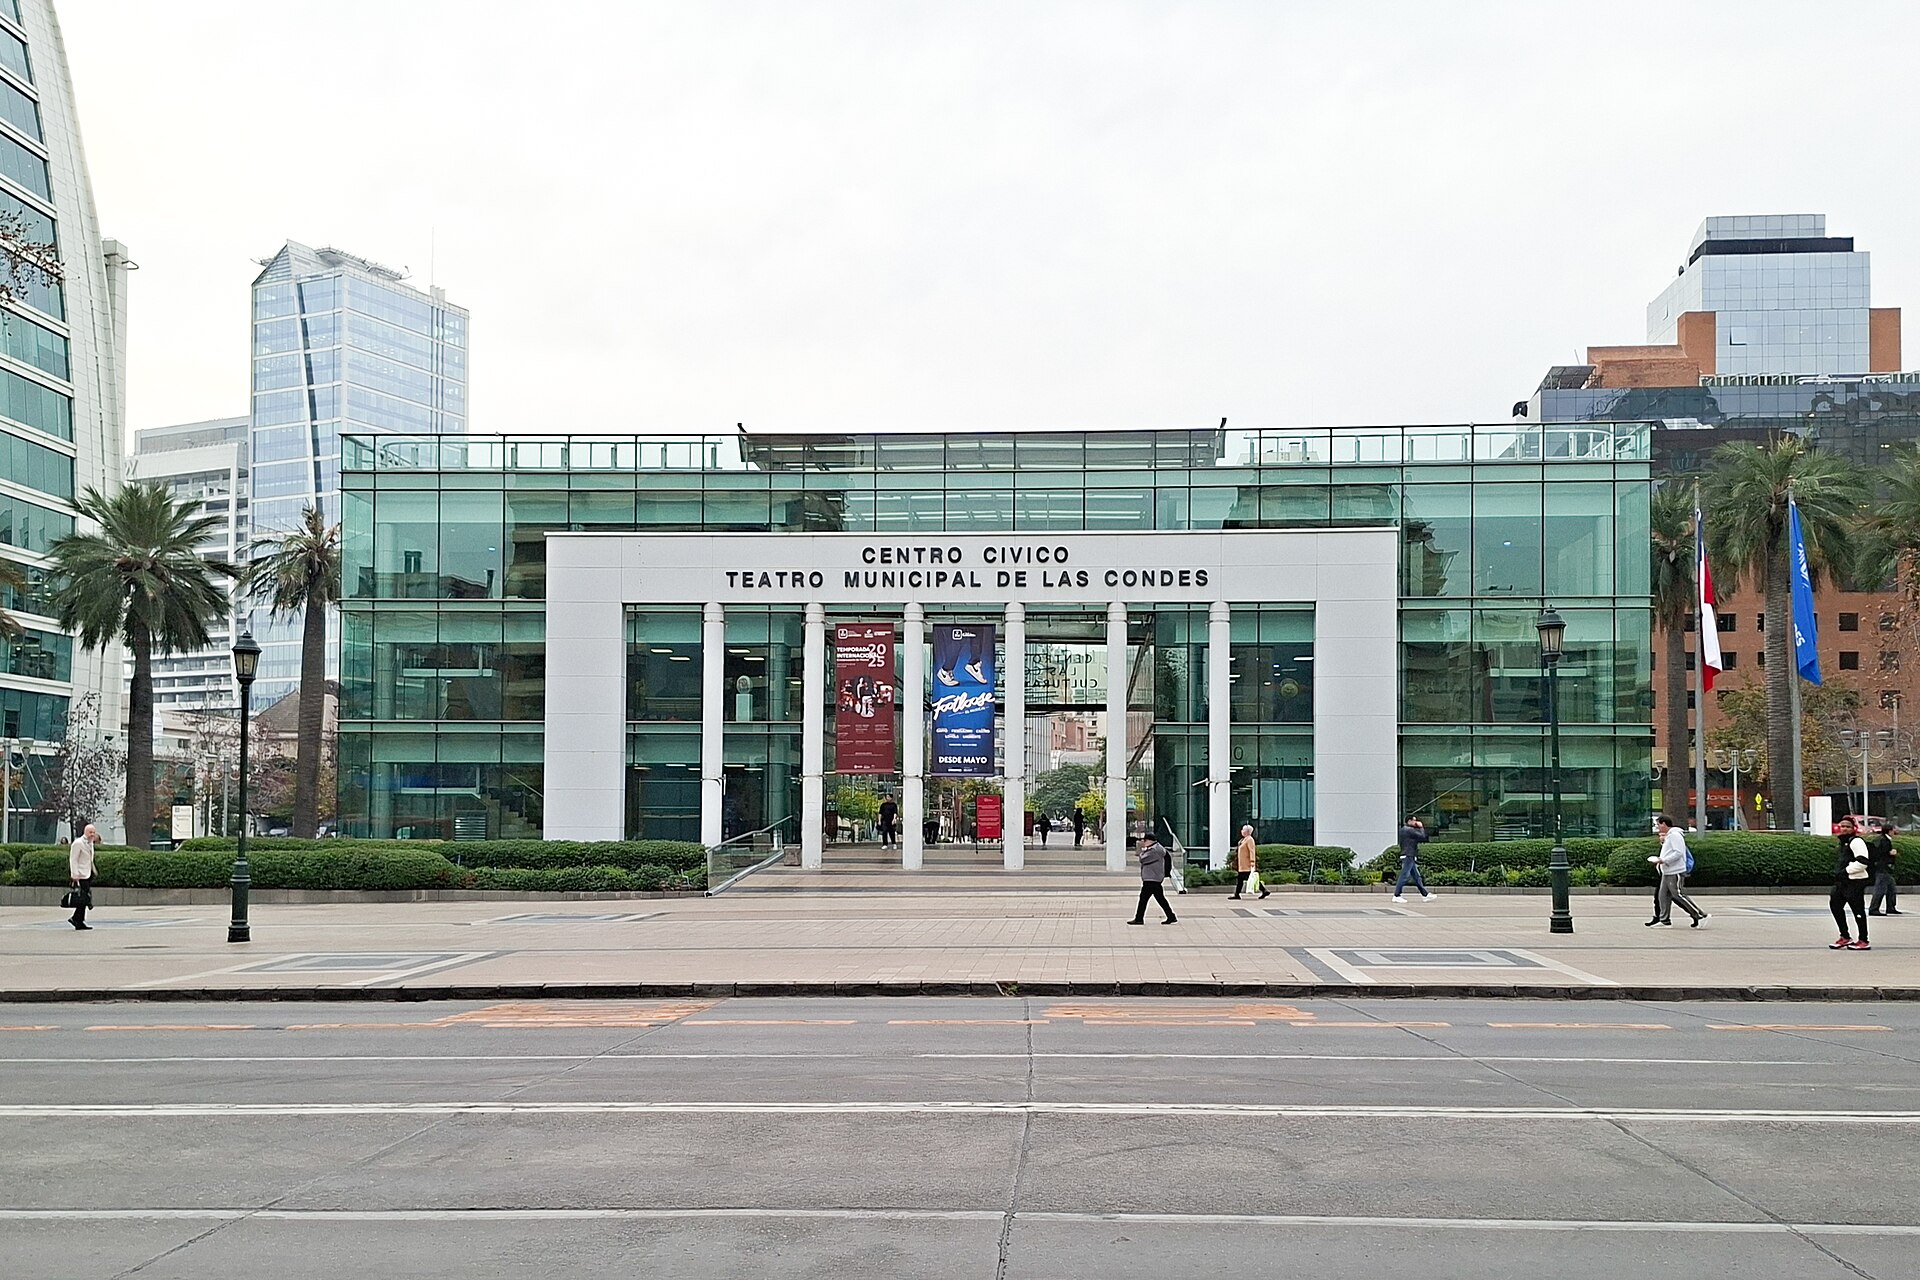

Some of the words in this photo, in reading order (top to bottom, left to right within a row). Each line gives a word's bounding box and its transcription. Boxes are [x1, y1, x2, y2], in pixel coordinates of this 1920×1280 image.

[862, 546, 962, 564] CENTRO
[983, 546, 1069, 564] CIVICO
[725, 571, 824, 589] TEATRO
[844, 570, 982, 589] MUNICIPAL
[996, 570, 1027, 588] DE
[1042, 570, 1089, 588] LAS
[1104, 569, 1209, 588] CONDES
[932, 692, 996, 721] Footloose
[938, 756, 962, 764] DESDE
[963, 756, 988, 764] MAYO
